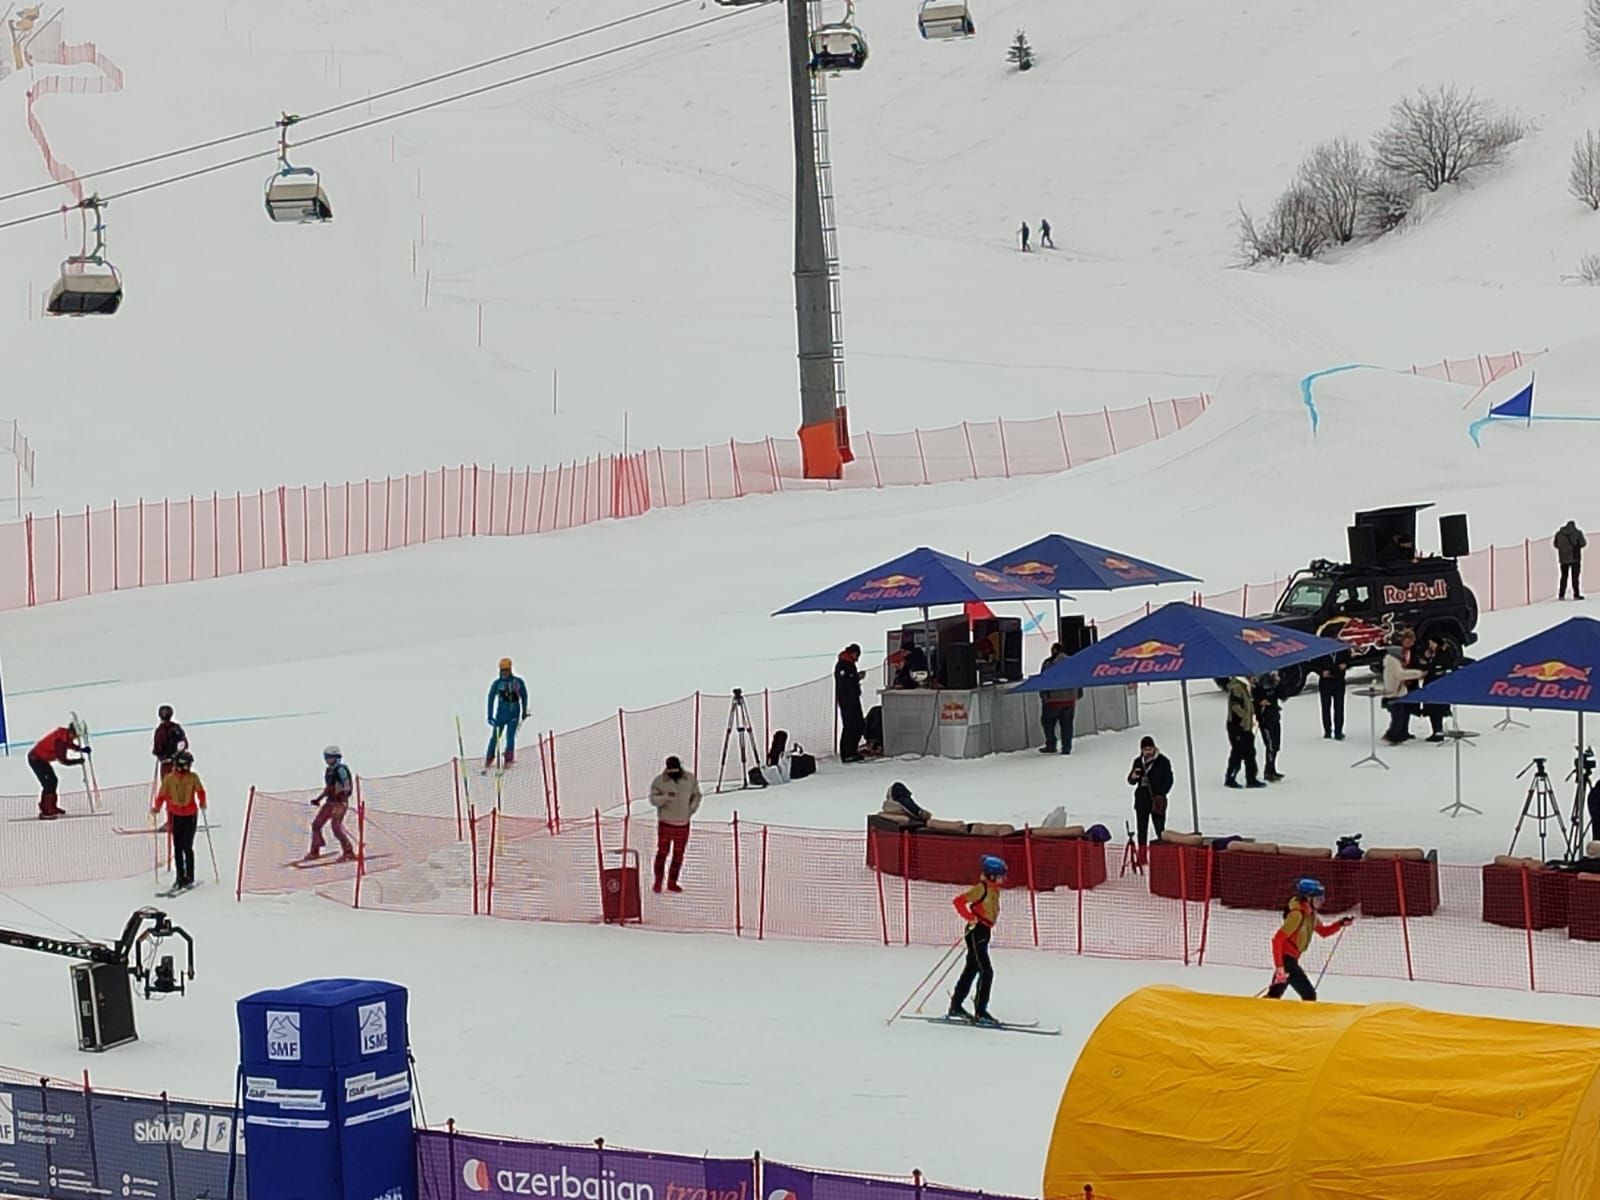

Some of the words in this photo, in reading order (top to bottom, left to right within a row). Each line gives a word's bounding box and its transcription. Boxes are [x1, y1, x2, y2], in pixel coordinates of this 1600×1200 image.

[845, 589, 882, 601] Red
[882, 587, 922, 598] Bull
[1384, 585, 1416, 604] Red
[1415, 579, 1447, 601] Bull
[1092, 660, 1138, 677] Red
[1137, 658, 1184, 673] Bull
[1489, 681, 1541, 697] Red
[1540, 684, 1592, 700] Bull
[269, 1041, 298, 1057] SMF
[134, 1120, 183, 1142] SkiMo
[497, 1165, 654, 1200] azerbaijan
